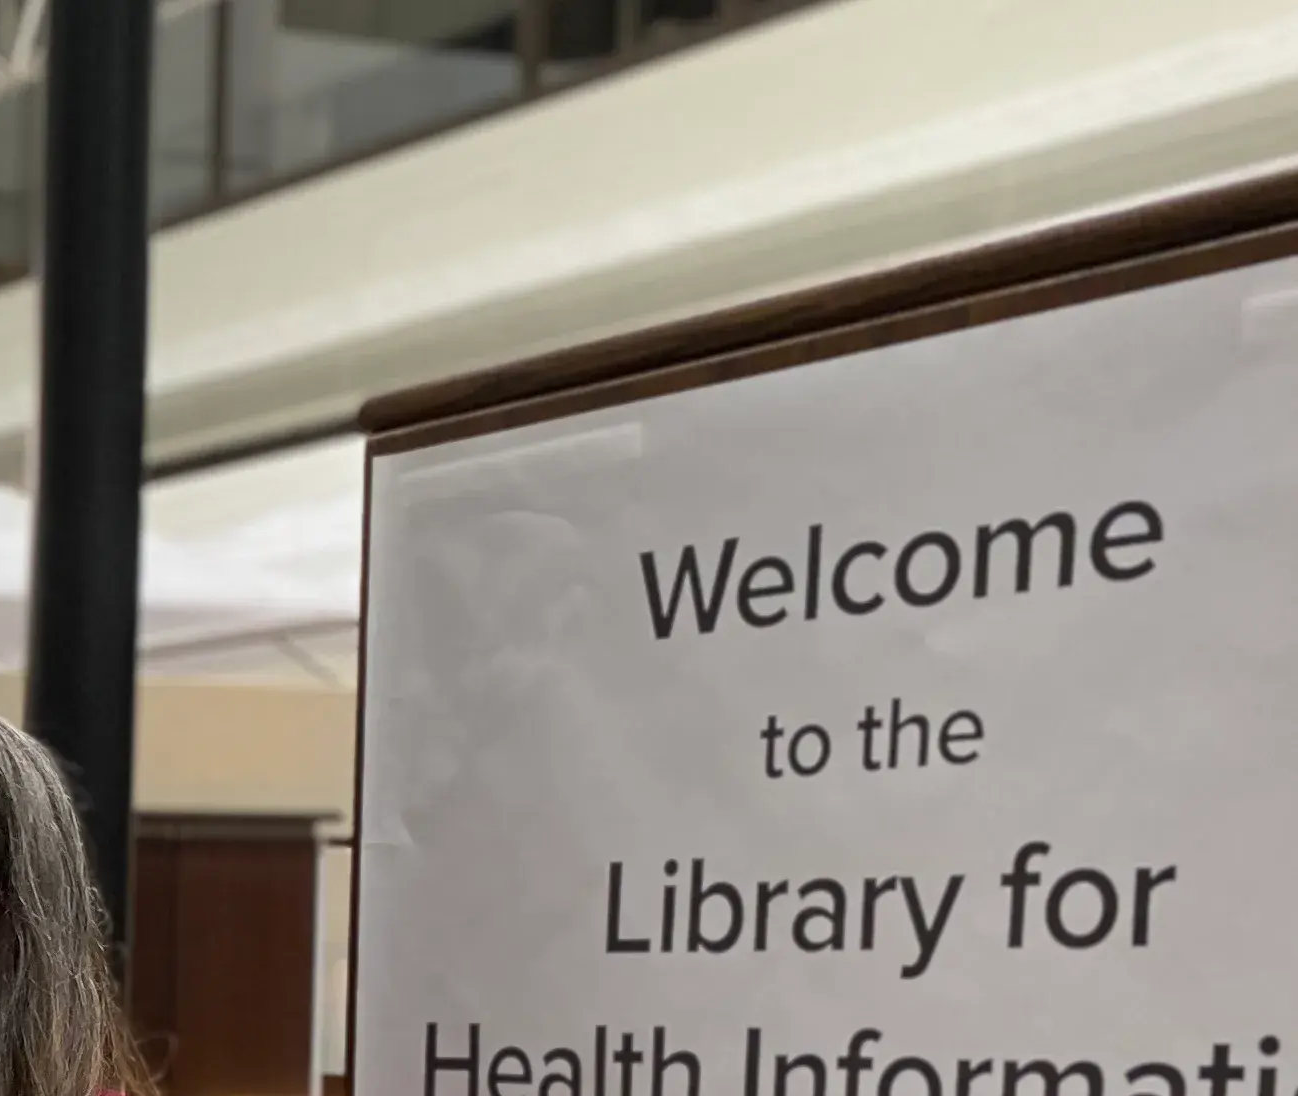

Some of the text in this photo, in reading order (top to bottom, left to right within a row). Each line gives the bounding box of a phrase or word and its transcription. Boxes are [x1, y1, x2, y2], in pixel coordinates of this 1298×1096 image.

[640, 501, 1164, 640] Welcome
[760, 698, 985, 779] to the
[606, 842, 1177, 979] Library for
